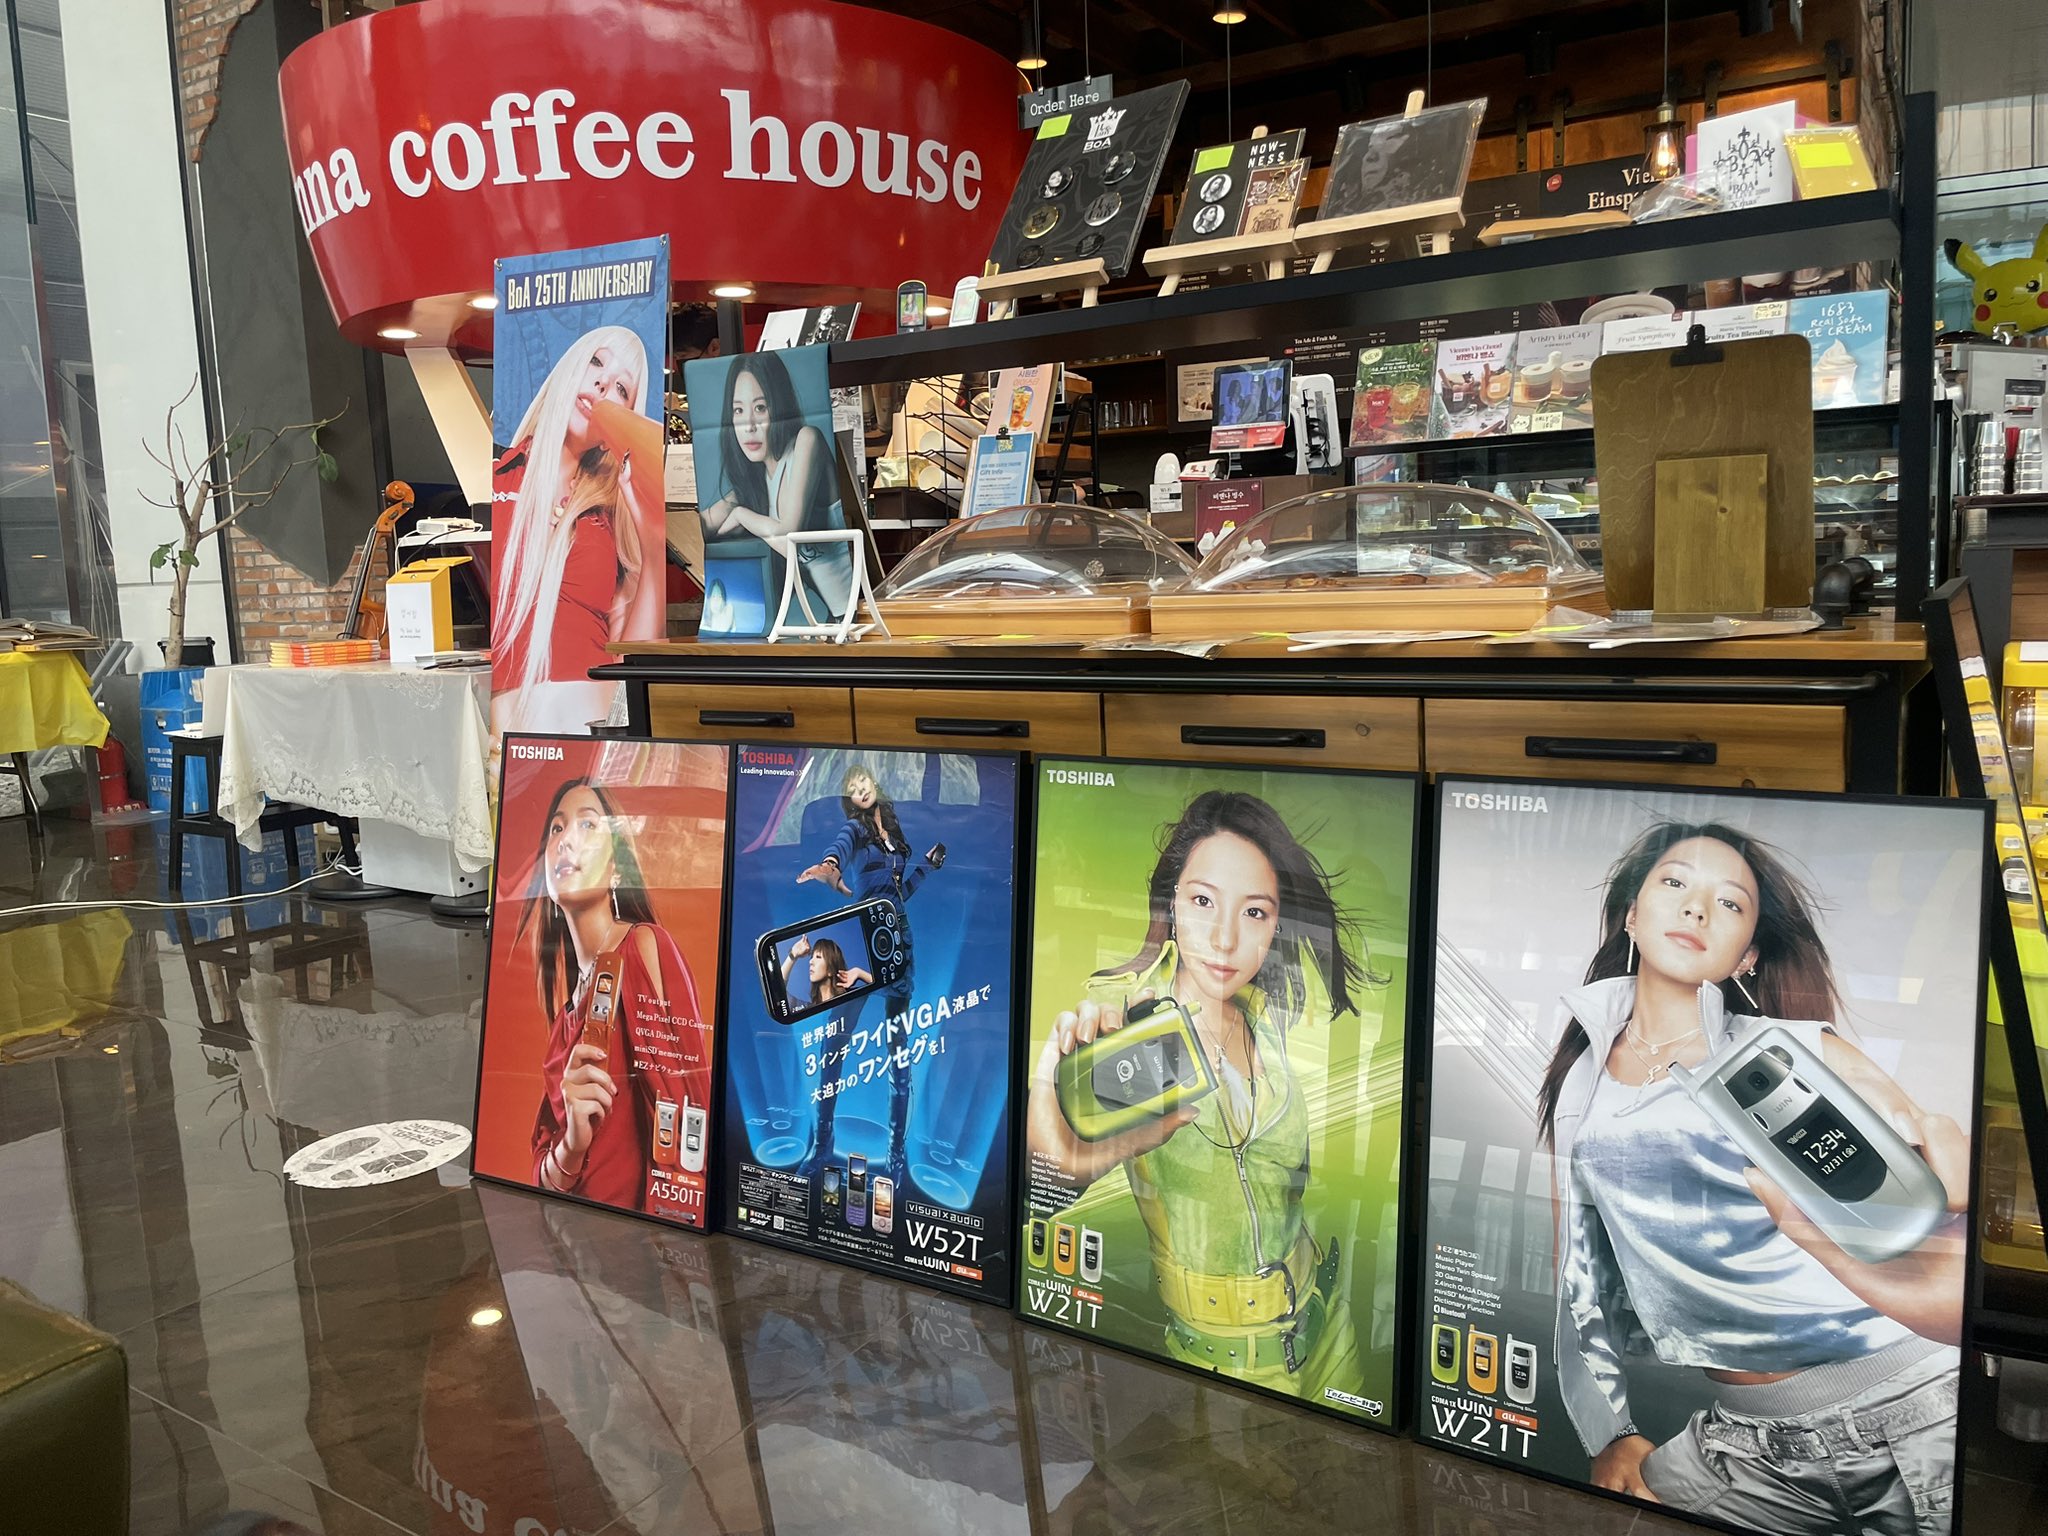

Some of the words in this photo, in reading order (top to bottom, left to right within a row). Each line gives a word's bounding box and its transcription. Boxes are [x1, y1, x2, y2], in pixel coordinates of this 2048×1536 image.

[1030, 100, 1066, 117] Order
[1069, 92, 1100, 108] Here
[389, 89, 695, 198] coffee
[719, 89, 982, 211] house
[1083, 138, 1111, 153] BoA
[1248, 152, 1285, 168] NESS
[508, 276, 531, 310] BoA
[535, 272, 567, 306] 25TH
[570, 260, 653, 303] ANNIVERSARY
[1821, 301, 1855, 317] 1683
[1811, 318, 1834, 328] Real
[1828, 323, 1873, 336] CREAM
[1741, 328, 1775, 339] Blending
[1365, 352, 1380, 362] NEW
[511, 745, 564, 761] TOSHIBA
[741, 752, 795, 766] TOSHIBA
[740, 766, 763, 777] Leading
[763, 767, 795, 777] Innovation
[1047, 769, 1115, 787] TOSHIBA
[1451, 792, 1548, 813] TOSHIBA
[637, 994, 648, 1003] TV
[648, 998, 671, 1007] output
[671, 1016, 687, 1026] CCD
[688, 1019, 713, 1031] Camera
[635, 1026, 655, 1037] QVGA
[656, 1031, 681, 1043] Display
[658, 1050, 684, 1061] memory
[684, 1053, 699, 1063] card
[1773, 1096, 1793, 1114] WIN
[1802, 1128, 1848, 1165] 12:34
[650, 1181, 704, 1207] A5501T
[905, 1219, 984, 1262] W52T
[923, 1255, 951, 1273] WIN
[1435, 1254, 1454, 1263] Music
[1454, 1257, 1475, 1268] Player
[1435, 1262, 1455, 1273] Stereo
[1456, 1267, 1471, 1276] Twin
[1470, 1270, 1497, 1282] Speaker
[1445, 1273, 1463, 1283] Game
[1045, 1279, 1072, 1296] WIN
[1435, 1279, 1457, 1290] 2.4inch
[1457, 1284, 1477, 1294] QVGA
[1477, 1288, 1501, 1301] Display
[1028, 1285, 1103, 1329] W21T
[1434, 1296, 1466, 1310] Dictionary
[1467, 1303, 1495, 1316] Function
[1458, 1293, 1485, 1306] Memory
[1485, 1299, 1502, 1310] Card
[1431, 1395, 1449, 1406] CDMA
[1456, 1397, 1493, 1418] WIN
[1502, 1412, 1515, 1422] au
[1432, 1404, 1538, 1459] W21T
